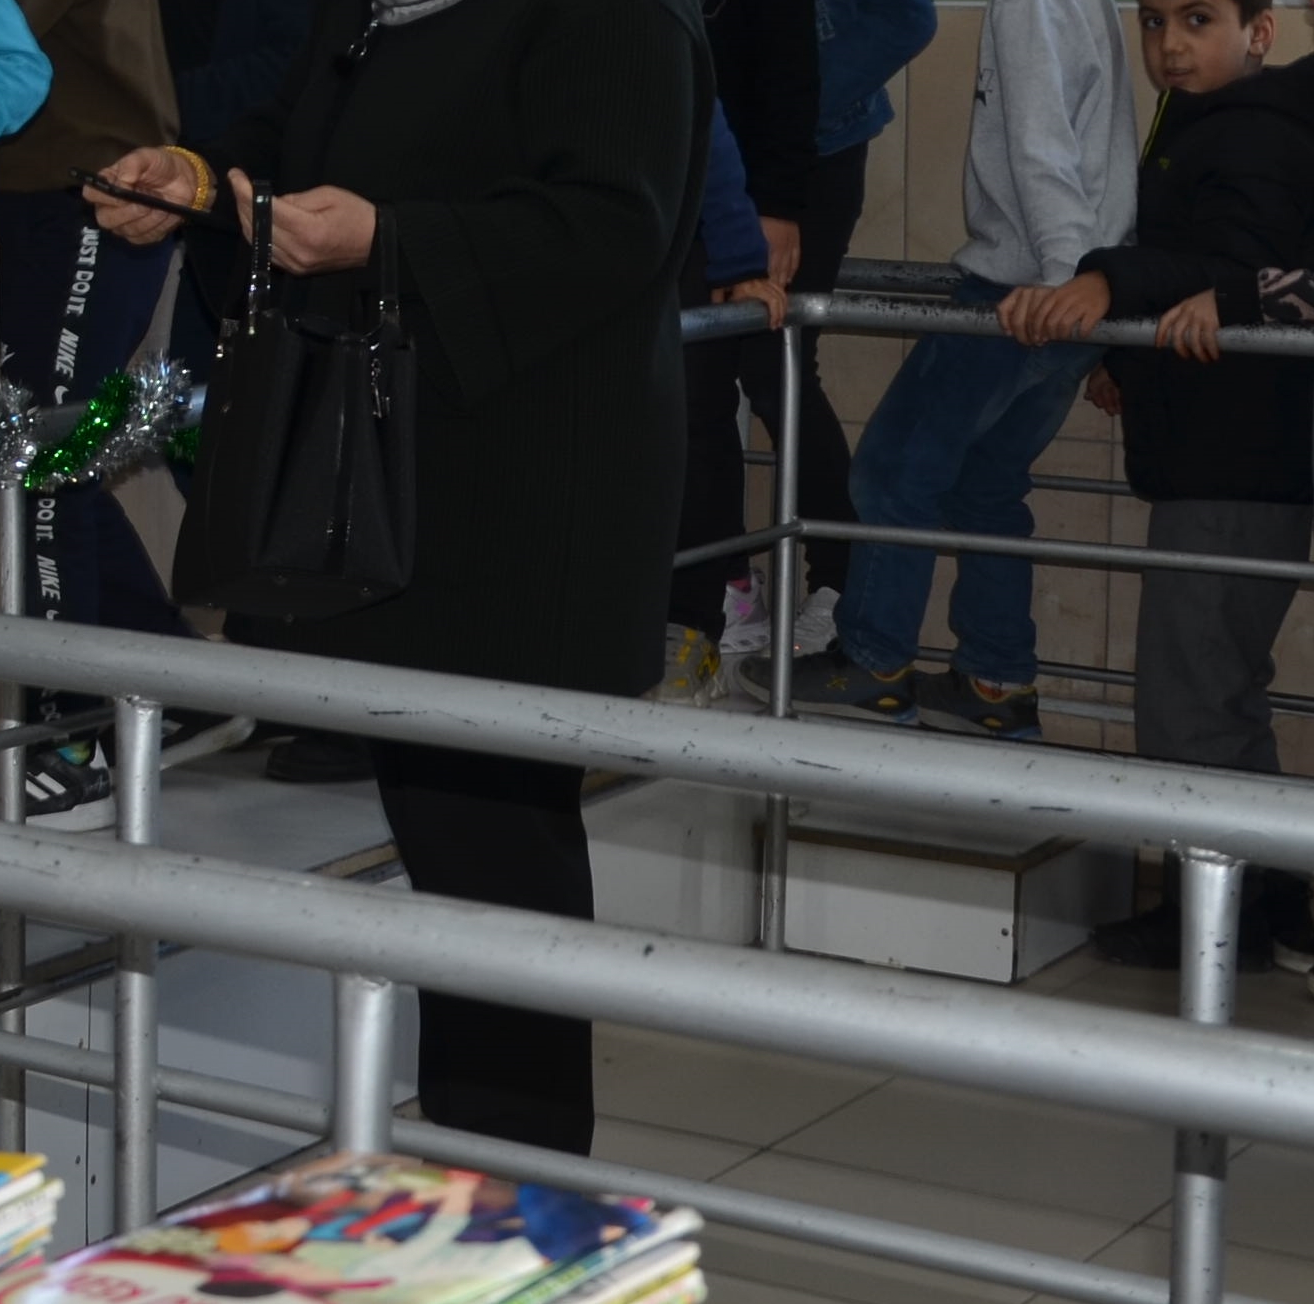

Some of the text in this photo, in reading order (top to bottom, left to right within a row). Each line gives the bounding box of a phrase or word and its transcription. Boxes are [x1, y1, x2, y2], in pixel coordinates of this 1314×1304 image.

[75, 225, 101, 266] JUST
[70, 269, 95, 295] DO
[54, 326, 81, 380] NIKE
[35, 497, 57, 523] DO
[35, 553, 62, 603] NIKE
